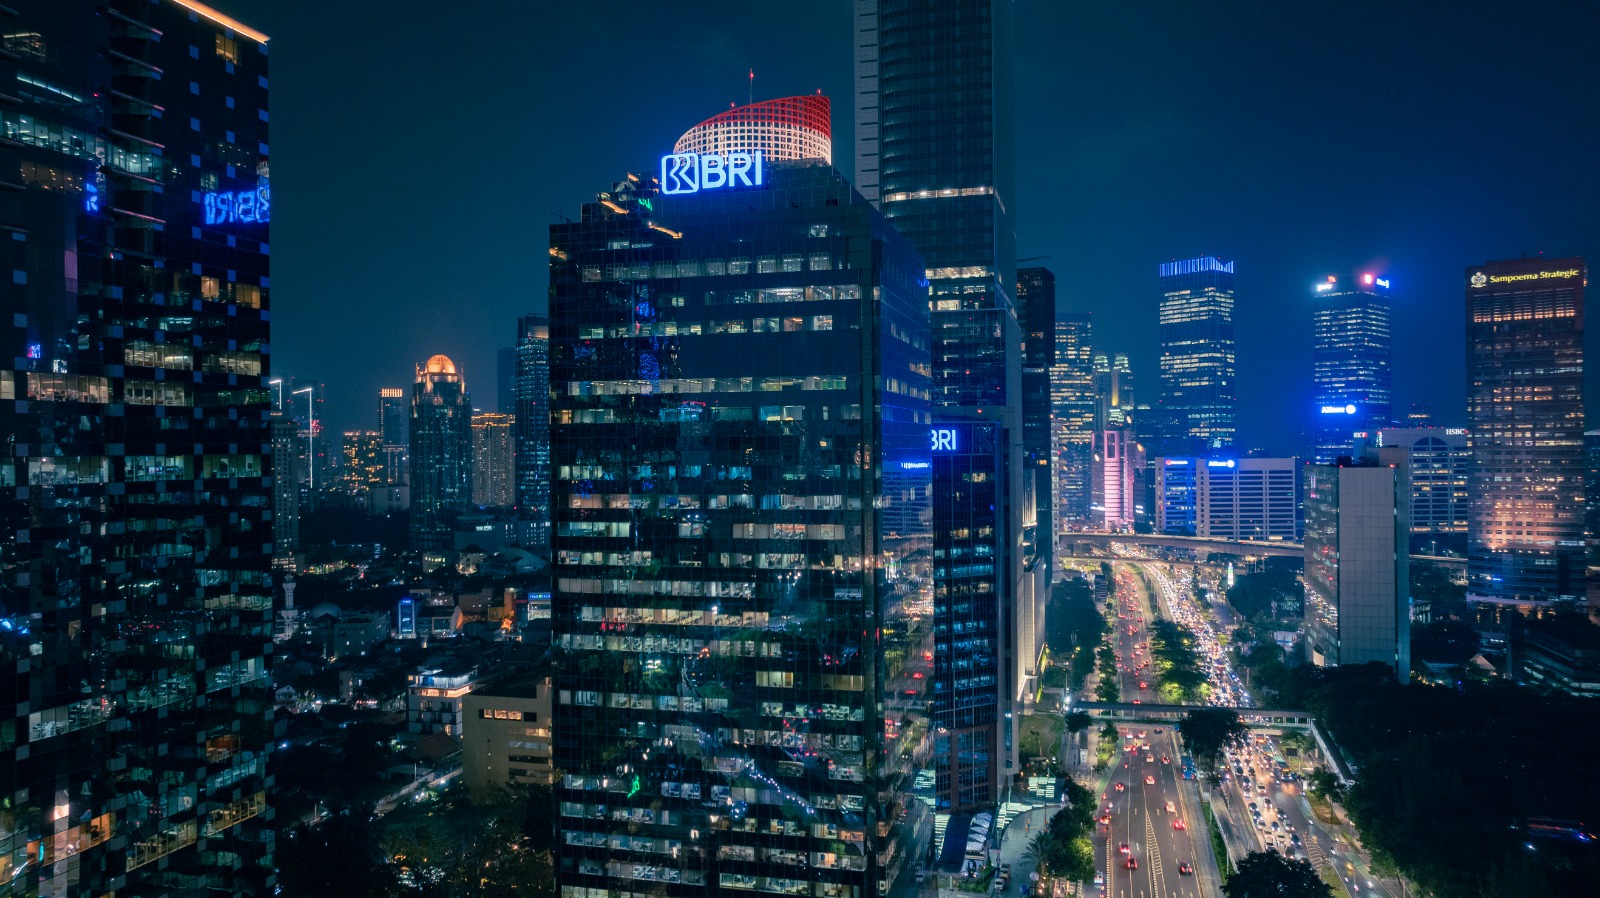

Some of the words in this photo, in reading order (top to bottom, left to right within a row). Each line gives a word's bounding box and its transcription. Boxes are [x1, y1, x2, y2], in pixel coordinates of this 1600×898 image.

[702, 150, 762, 189] BRI
[1490, 273, 1539, 284] Sampoerna
[1540, 268, 1580, 279] Strategic
[931, 429, 957, 451] BRI
[1445, 428, 1466, 436] HSBC
